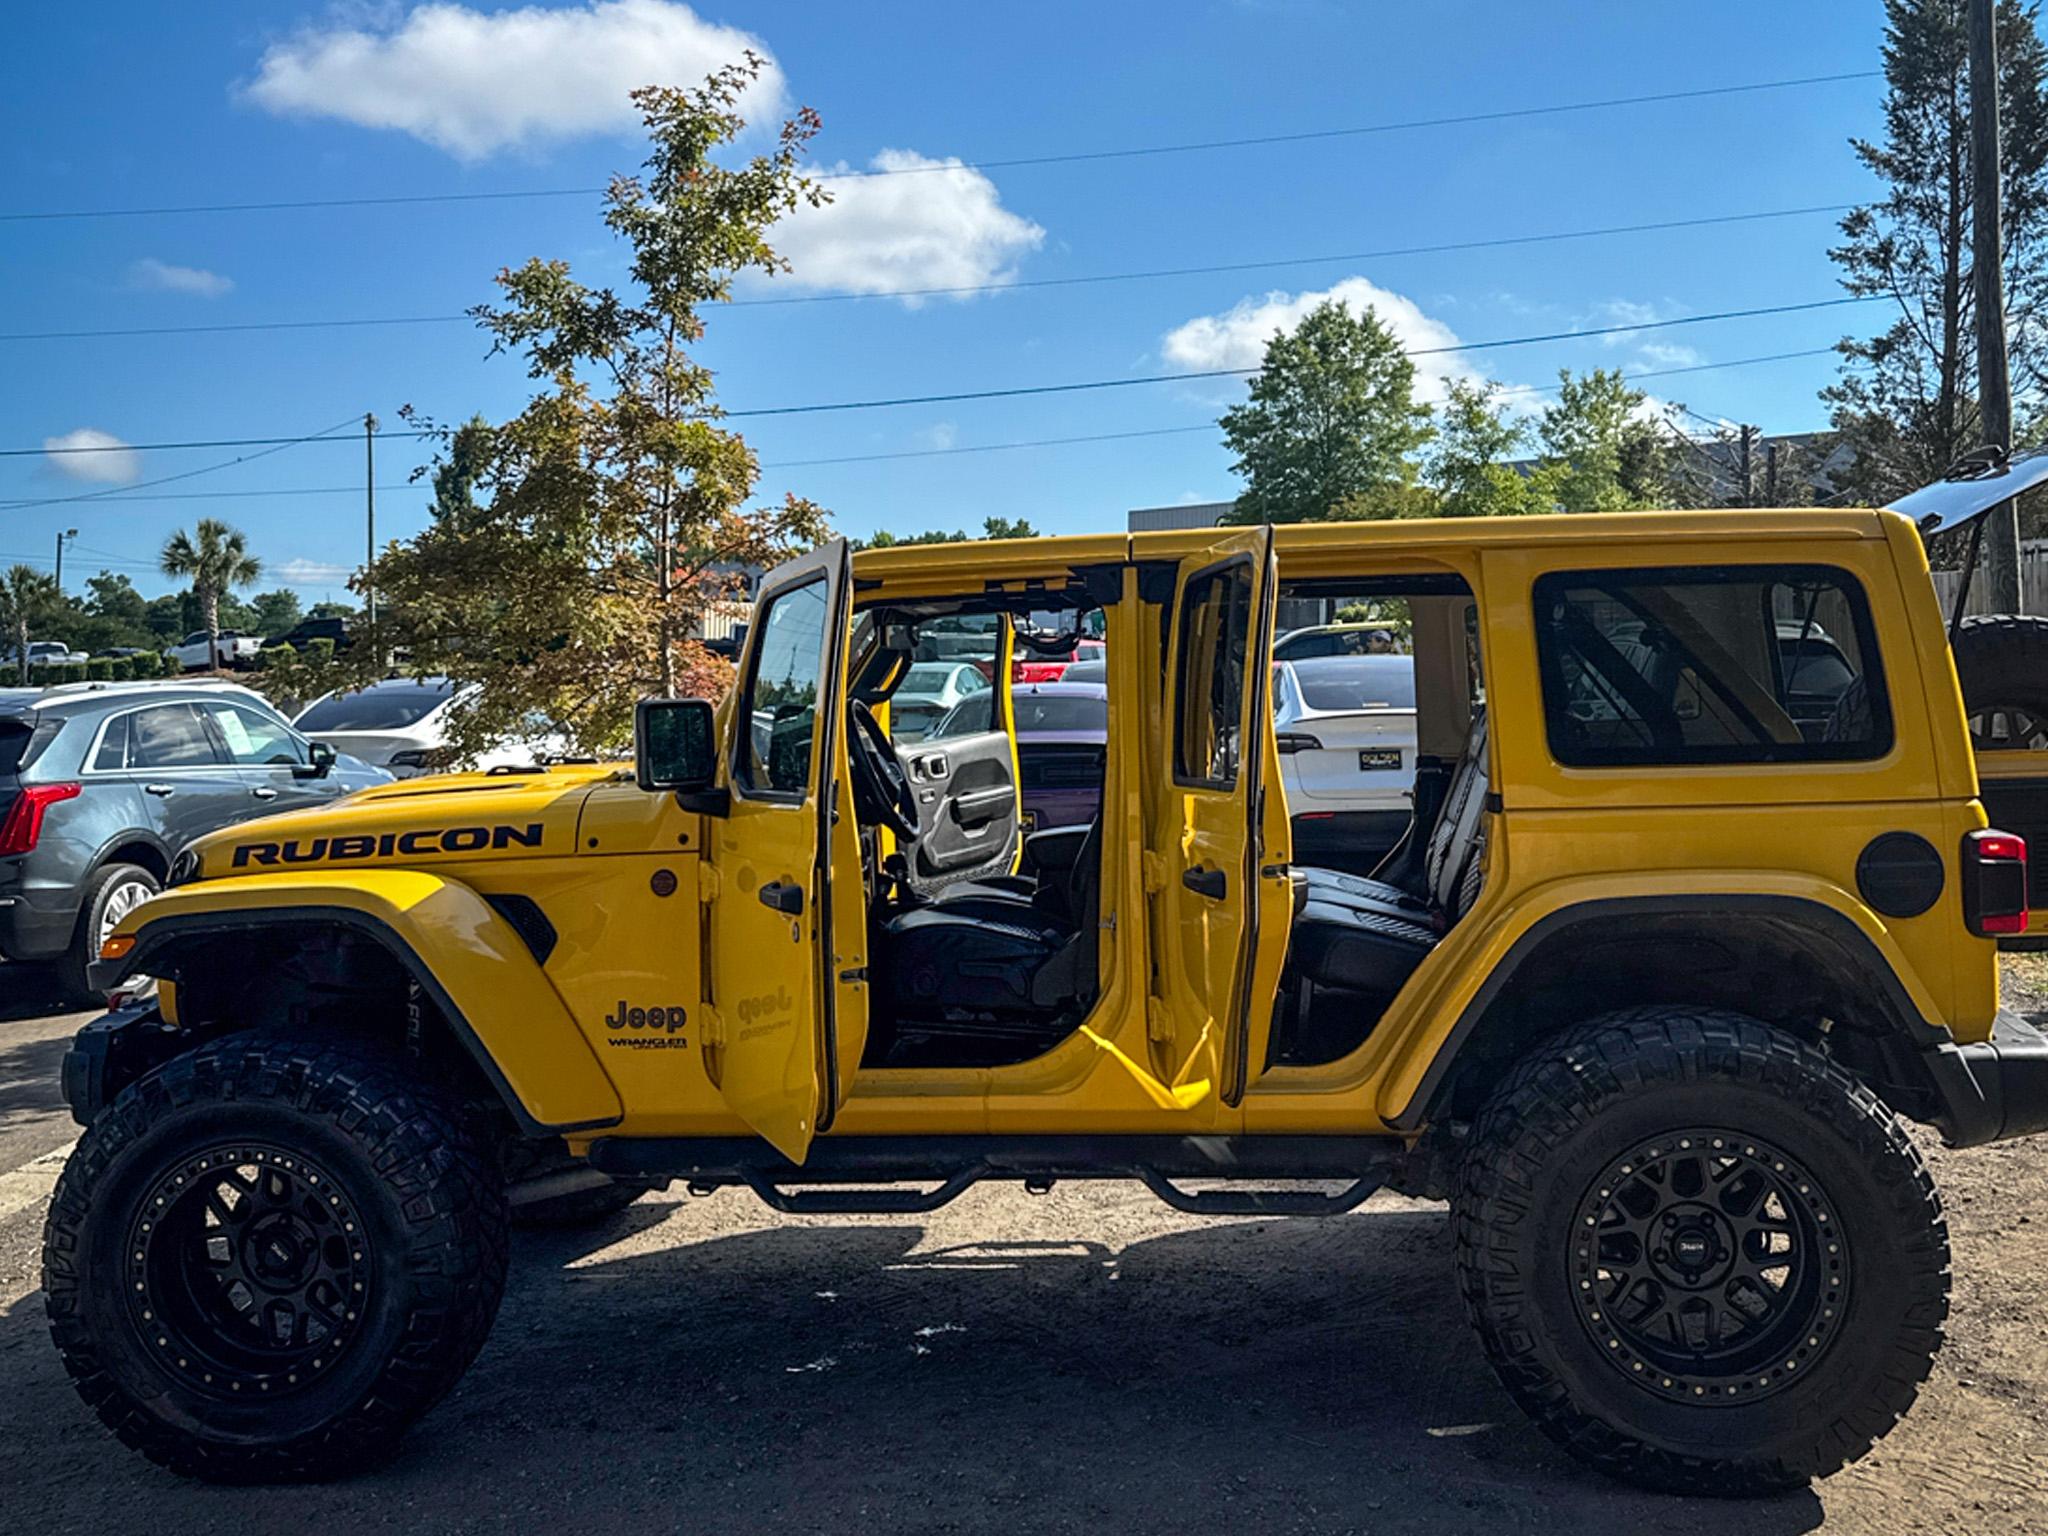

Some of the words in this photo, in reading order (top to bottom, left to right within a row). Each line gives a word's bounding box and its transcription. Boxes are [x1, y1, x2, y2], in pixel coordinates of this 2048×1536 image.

[231, 823, 544, 868] RUBICON
[605, 1000, 687, 1033] Jeep
[607, 1038, 687, 1047] WRANGLER
